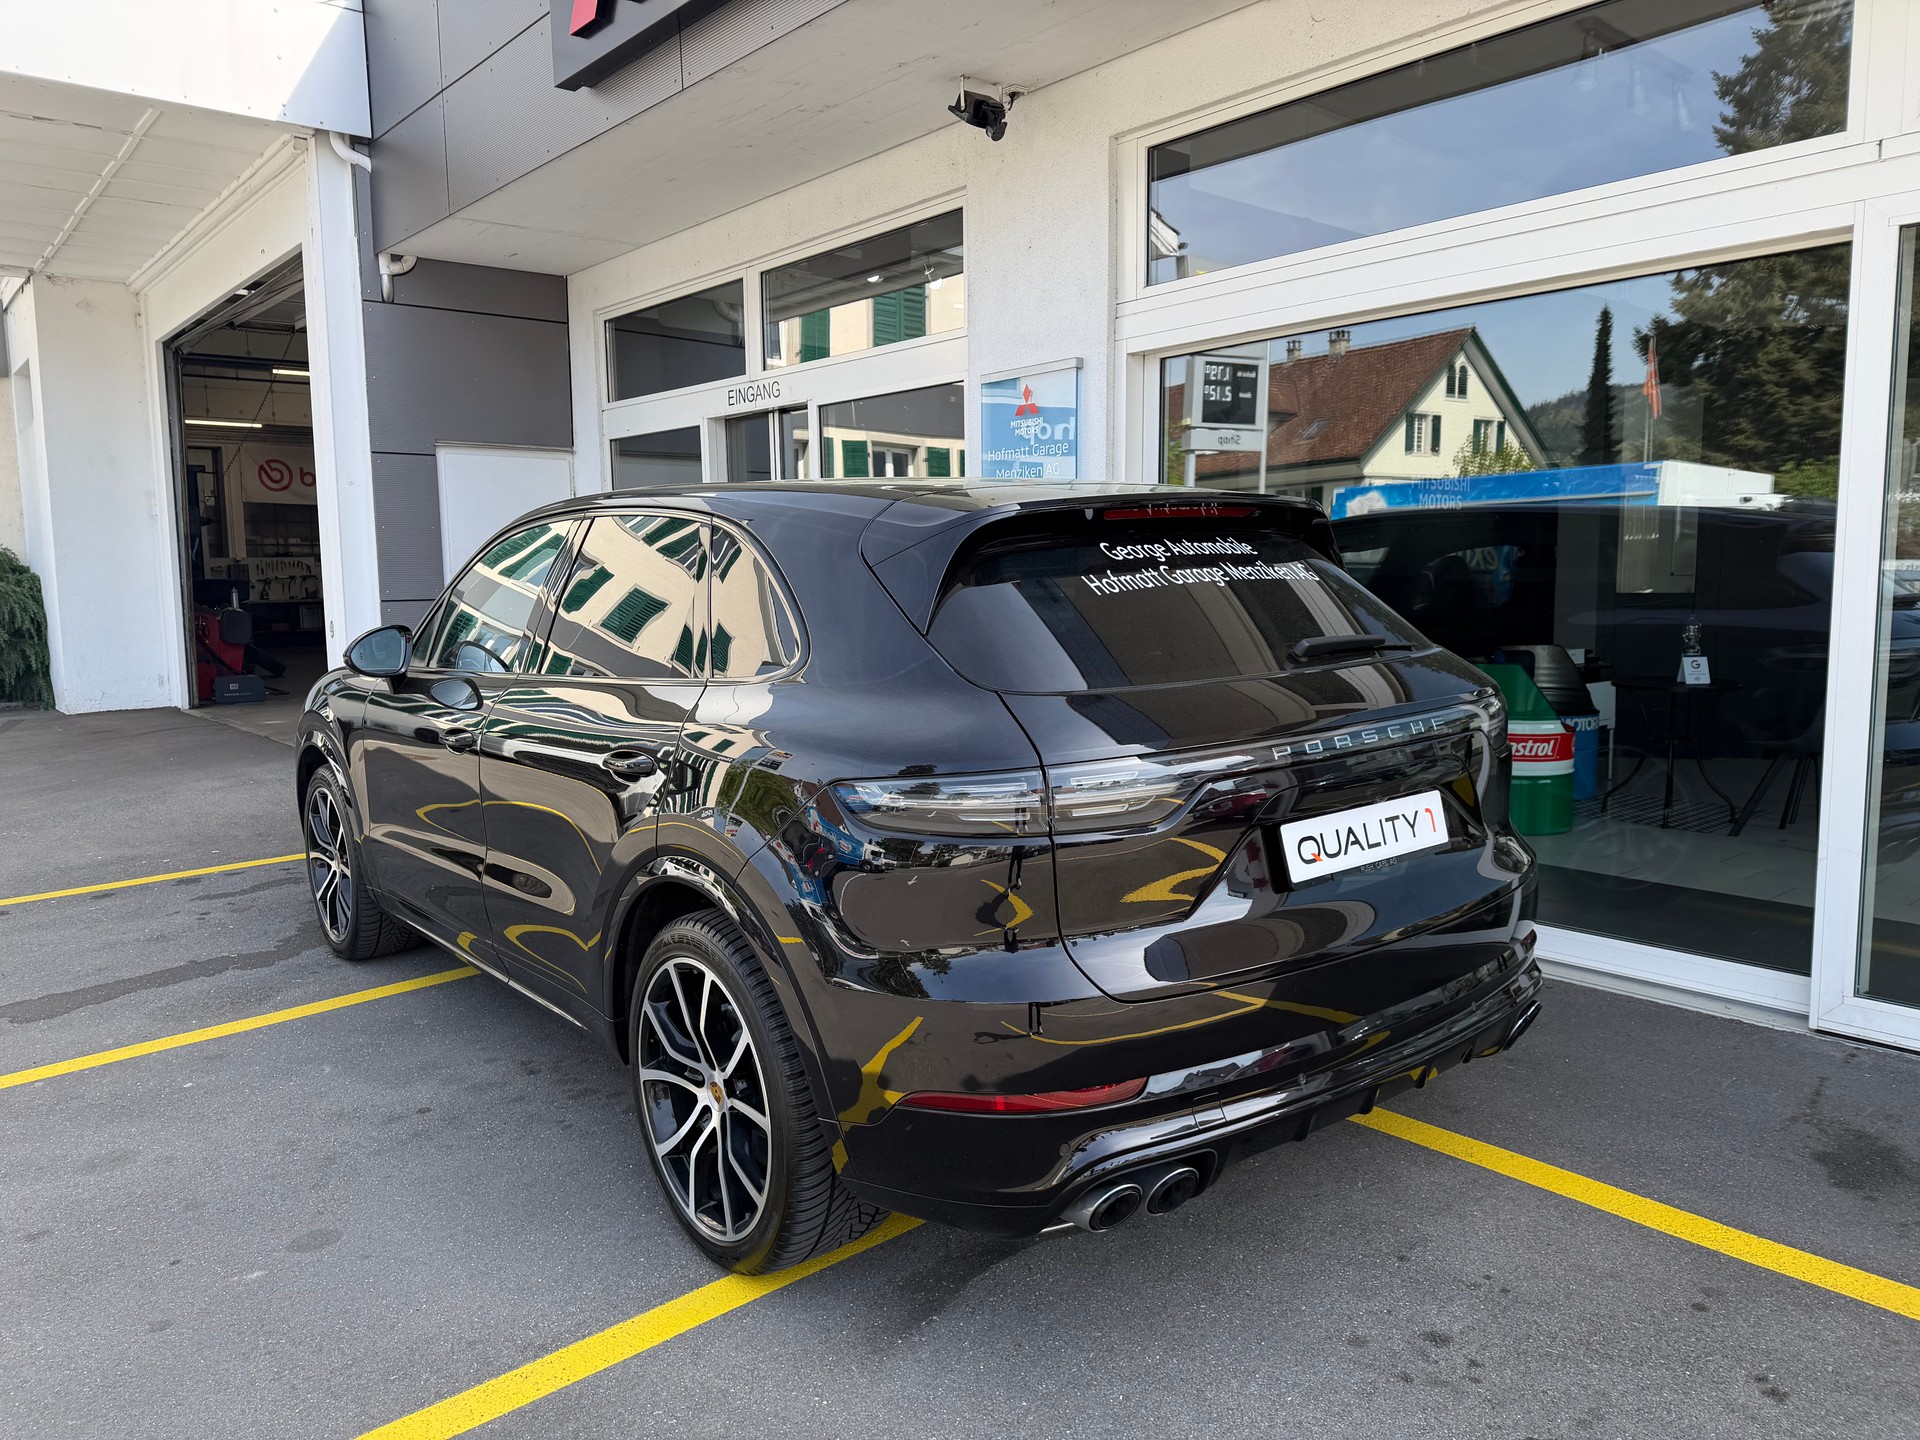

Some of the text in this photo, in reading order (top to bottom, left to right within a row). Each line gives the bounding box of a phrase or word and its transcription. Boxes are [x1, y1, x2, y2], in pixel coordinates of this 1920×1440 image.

[728, 381, 780, 406] EINGANG
[1010, 417, 1043, 428] MITSUBISHI
[1015, 426, 1039, 436] MOTORS
[988, 443, 1069, 461] Hofmatt Garage
[996, 463, 1060, 478] Menziken AG
[1412, 475, 1470, 492] MITSUBISHI
[1419, 493, 1462, 510] MOTORS
[1100, 536, 1258, 561] George Automobile
[1081, 561, 1319, 595] Hofmatt Garage Menziken AG
[1272, 717, 1445, 760] PORSCHE
[1510, 740, 1554, 756] astrol
[1297, 810, 1418, 864] QUALITY
